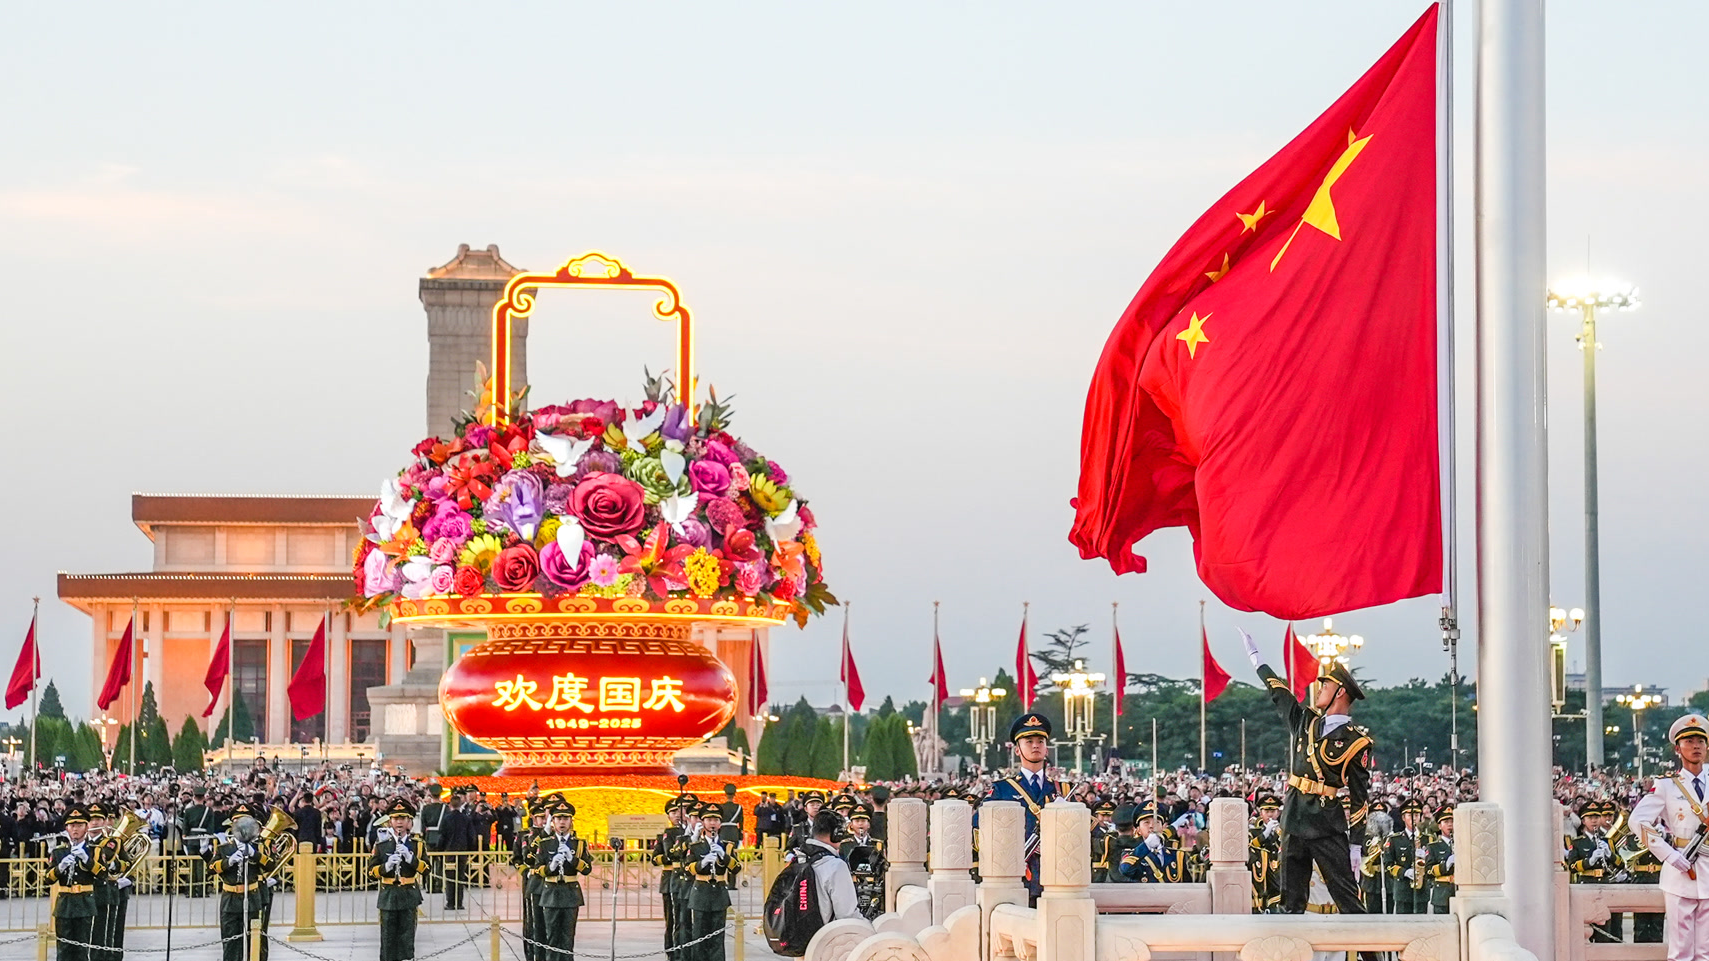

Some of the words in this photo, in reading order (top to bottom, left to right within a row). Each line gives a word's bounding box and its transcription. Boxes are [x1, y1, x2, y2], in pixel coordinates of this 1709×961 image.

[492, 672, 686, 713] 欢度国庆
[546, 718, 642, 729] 1949-2025
[799, 879, 808, 911] CHINA
